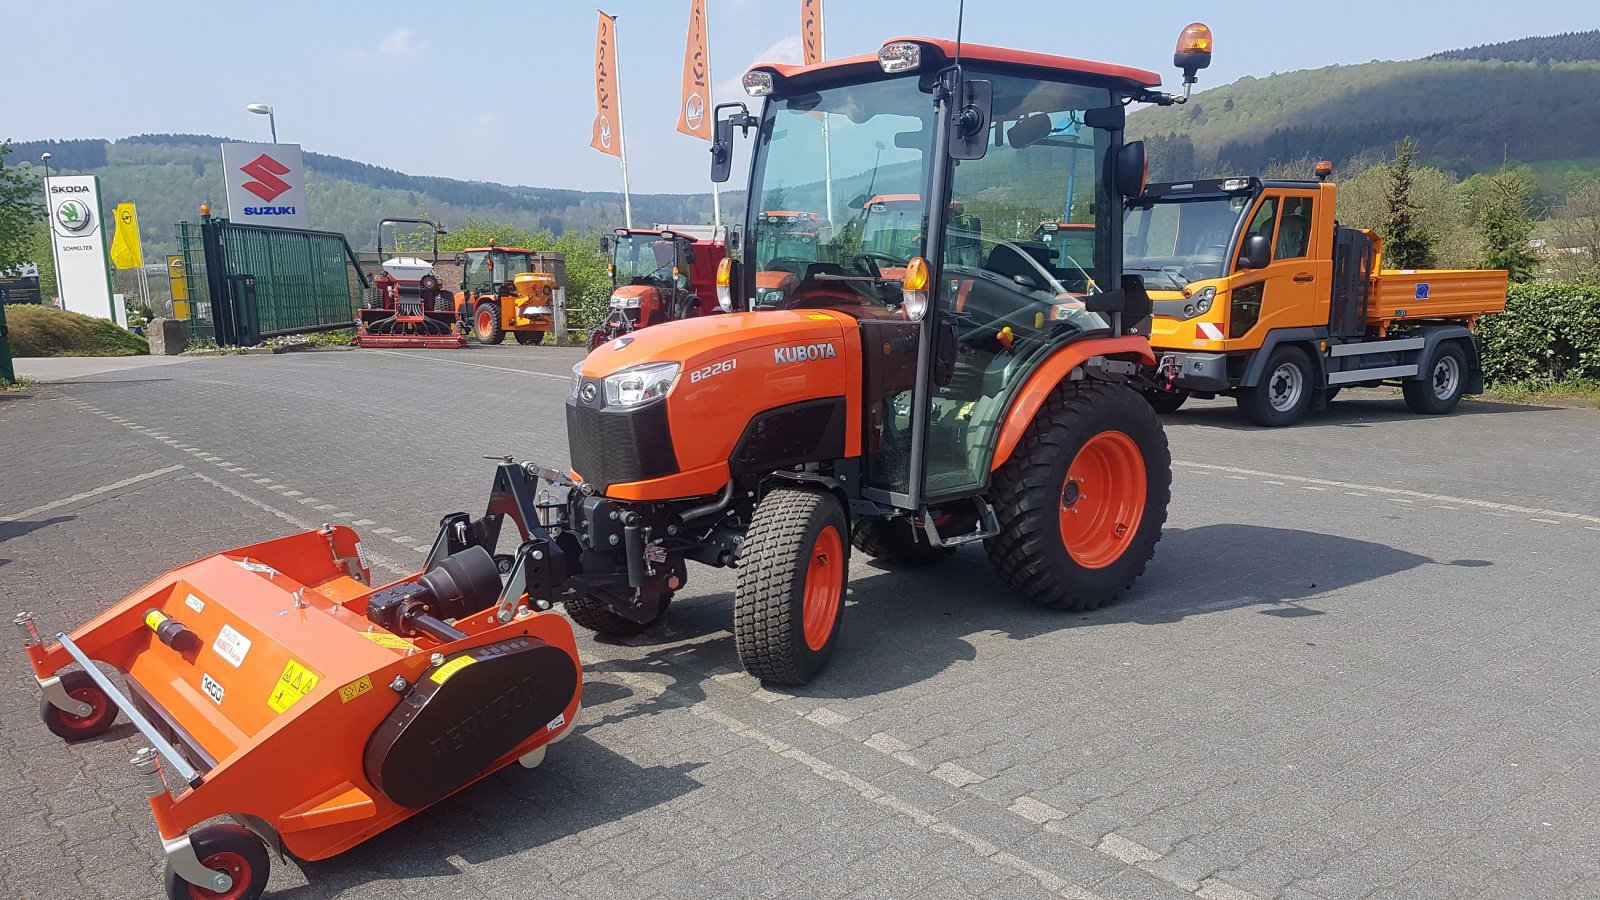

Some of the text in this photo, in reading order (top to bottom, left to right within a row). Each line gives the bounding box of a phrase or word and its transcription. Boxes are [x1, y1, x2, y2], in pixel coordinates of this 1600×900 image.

[243, 206, 296, 216] SUZUKI
[774, 342, 837, 364] KUBOTA
[690, 358, 738, 384] B2261
[204, 677, 223, 702] 1400
